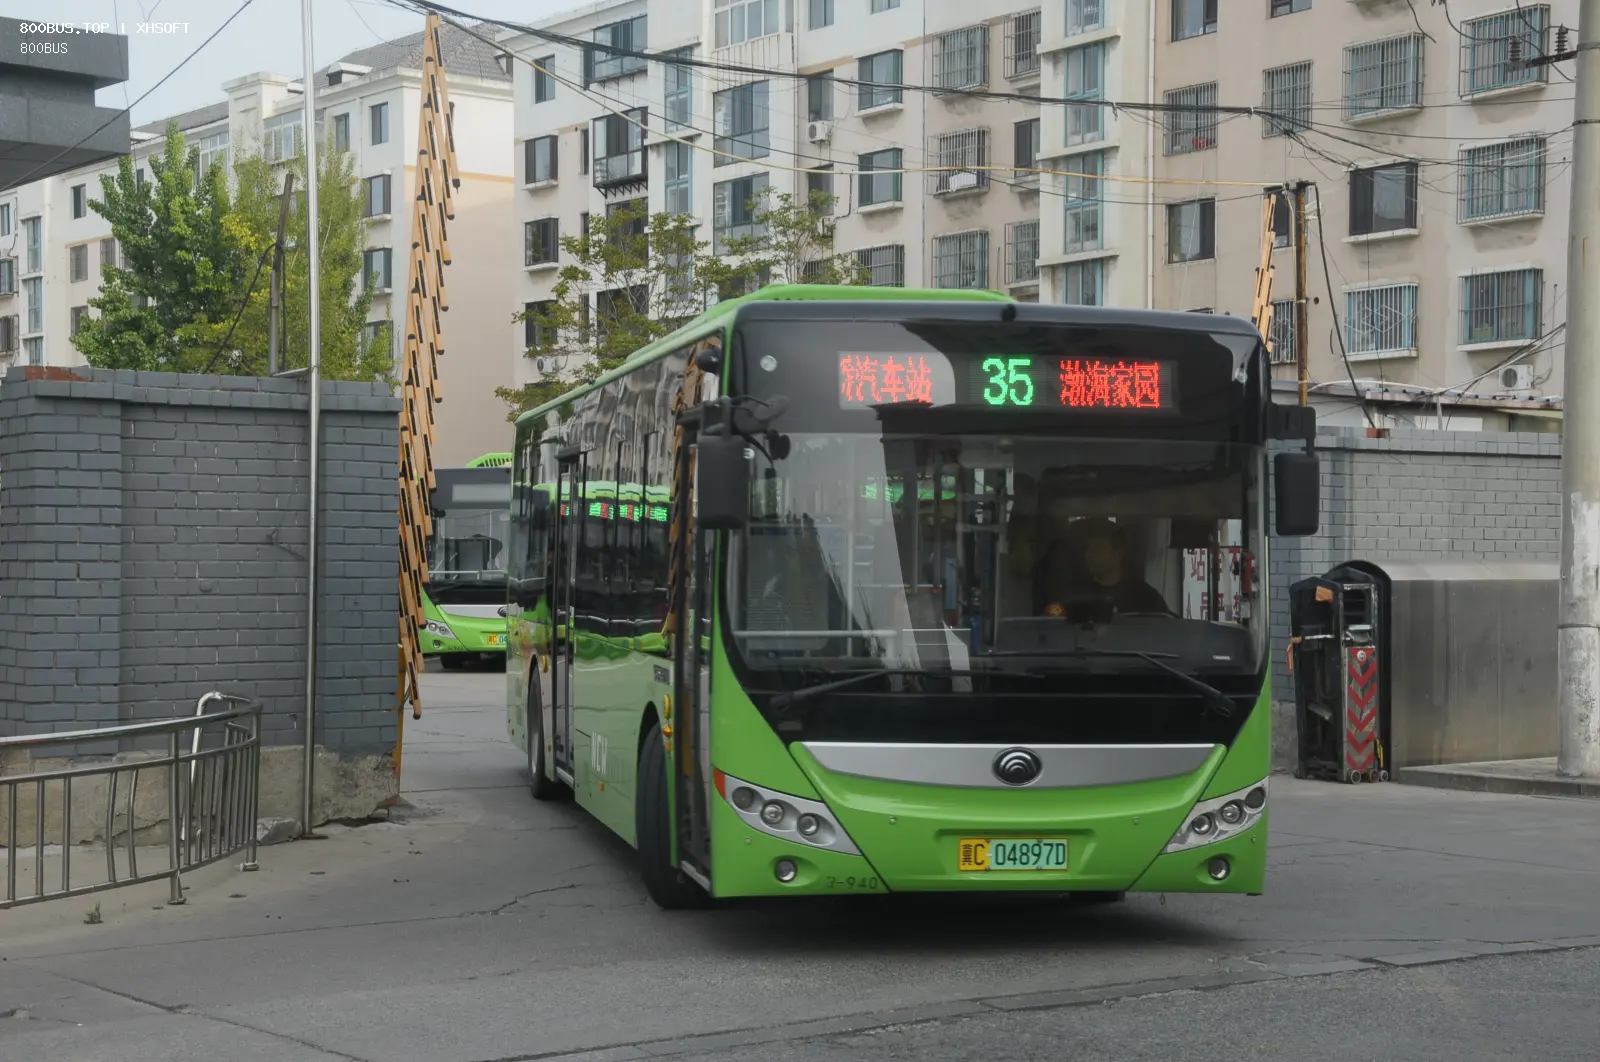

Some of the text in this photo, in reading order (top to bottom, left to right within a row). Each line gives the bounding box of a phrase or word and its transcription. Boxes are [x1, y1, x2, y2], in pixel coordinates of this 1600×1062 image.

[982, 357, 1034, 406] 35
[995, 843, 1066, 866] 04897D
[825, 876, 878, 889] 3-940
